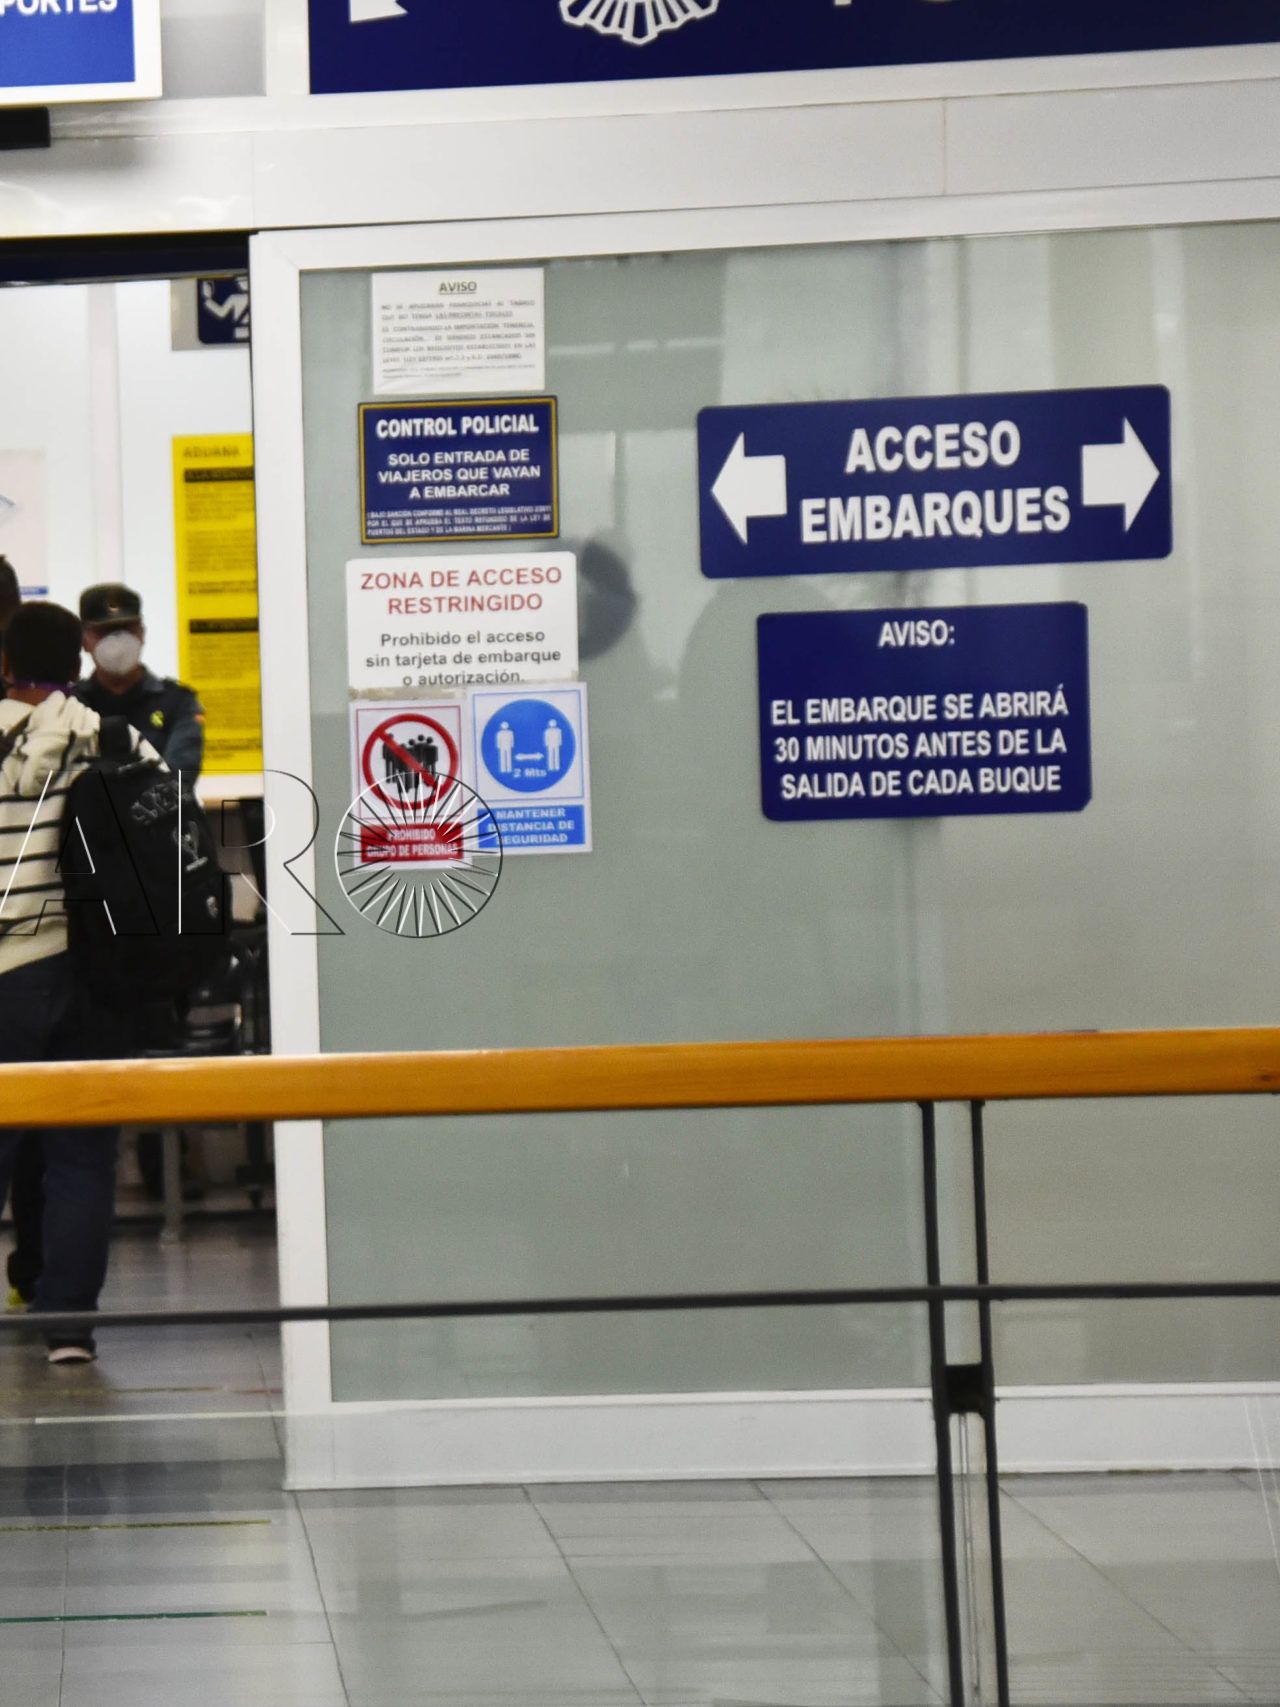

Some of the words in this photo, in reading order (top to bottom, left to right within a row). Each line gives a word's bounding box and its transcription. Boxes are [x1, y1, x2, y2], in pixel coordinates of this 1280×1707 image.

[438, 281, 477, 293] AVISO
[376, 417, 457, 438] CONTROL
[461, 414, 539, 435] POLICIAL
[844, 419, 1022, 474] ACCESO
[388, 452, 430, 466] SOLO
[434, 450, 506, 465] ENTRADA
[509, 448, 530, 462] DE
[378, 469, 453, 483] VIAJEROS
[457, 467, 489, 481] QUE
[492, 465, 541, 479] VAYAN
[408, 486, 421, 499] A
[424, 483, 510, 499] EMBARCAR
[800, 485, 1071, 544] EMBARQUES
[360, 572, 424, 590] ZONA
[430, 571, 460, 588] DE
[467, 566, 562, 586] ACCESO
[387, 593, 543, 614] RESTRINGIDO
[380, 631, 461, 647] Prohibido
[467, 631, 481, 644] el
[486, 630, 545, 643] acceso
[878, 619, 955, 648] AVISO:
[366, 653, 390, 668] sin
[395, 652, 447, 669] tarjeta
[453, 650, 473, 665] de
[478, 649, 561, 664] embarque
[403, 676, 413, 687] o
[419, 670, 526, 687] autorización.
[771, 700, 799, 726] EL
[806, 694, 937, 725] EMBARQUE
[944, 692, 974, 720] SE
[979, 683, 1069, 718] ABRIRÁ
[775, 737, 800, 762] 30
[806, 732, 909, 761] MINUTOS
[914, 730, 992, 758] ANTES
[999, 729, 1029, 755] DE
[1035, 728, 1067, 754] LA
[514, 768, 521, 778] 2
[781, 771, 866, 799] SALIDA
[871, 770, 902, 796] DE
[908, 767, 975, 795] CADA
[980, 765, 1062, 793] BUQUE
[496, 808, 566, 820] MANTENER
[387, 829, 436, 841] PROHIBIDO
[488, 821, 555, 832] DISTANCIA
[559, 820, 575, 830] DE
[496, 833, 568, 845] SEGURIDAD
[367, 844, 396, 857] GRUPO
[398, 845, 410, 857] DE
[412, 843, 458, 857] PERSONAS
